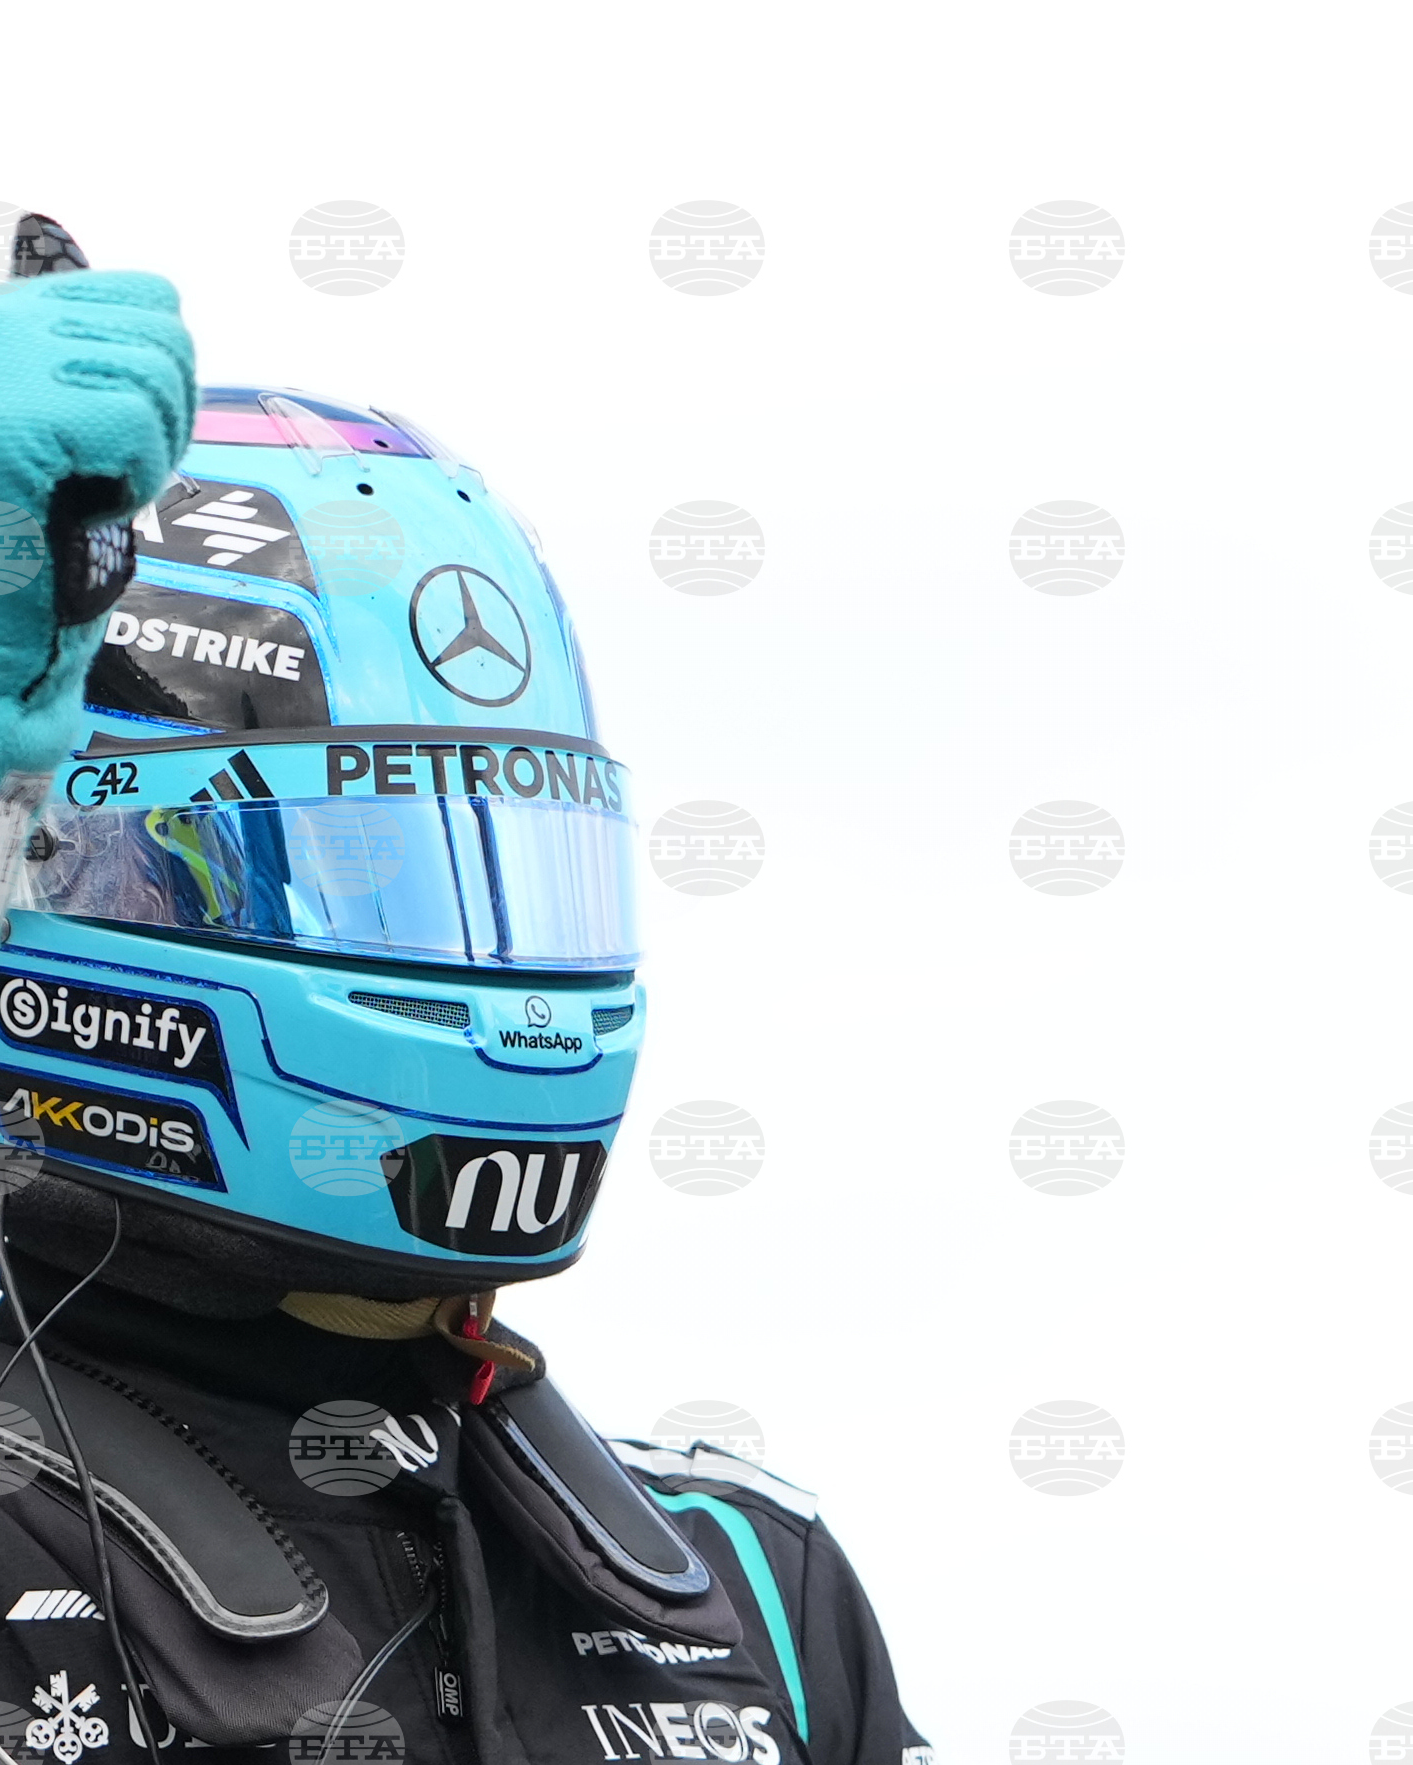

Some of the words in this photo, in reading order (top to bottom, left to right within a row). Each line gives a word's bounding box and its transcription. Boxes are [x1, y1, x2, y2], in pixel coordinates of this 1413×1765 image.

[104, 612, 305, 681] DSTRIKE
[66, 762, 139, 811] G42
[326, 744, 622, 812] PETRONAS
[0, 978, 206, 1068] Signify
[498, 1030, 582, 1054] WhatsApp
[443, 1672, 460, 1716] OMP
